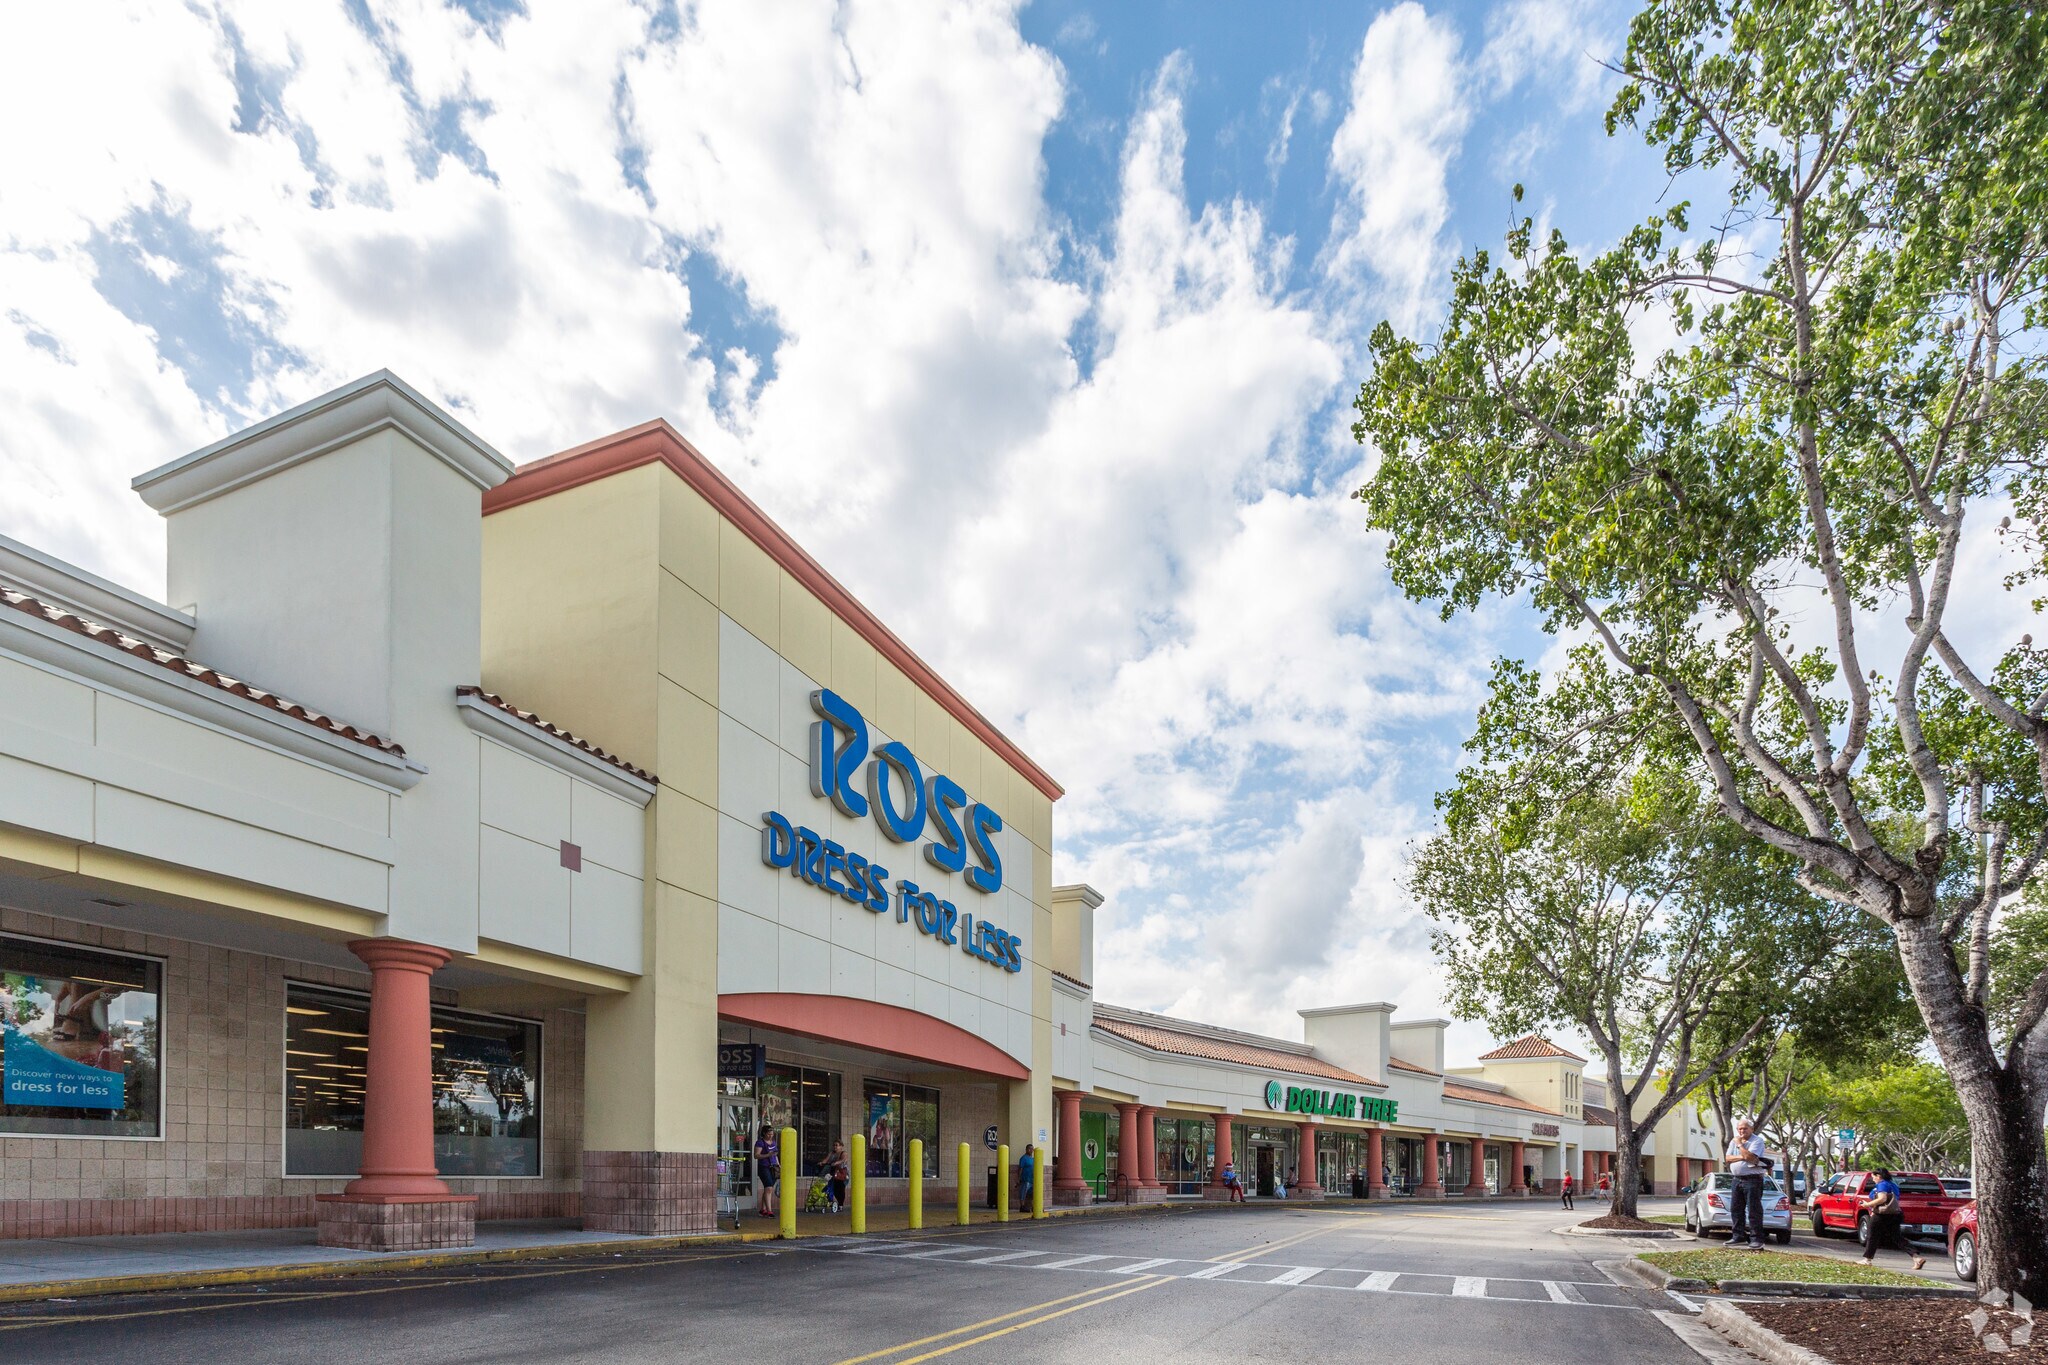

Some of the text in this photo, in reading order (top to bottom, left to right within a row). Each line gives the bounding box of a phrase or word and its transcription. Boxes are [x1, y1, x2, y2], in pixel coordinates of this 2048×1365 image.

[810, 688, 1002, 893] ROSS
[762, 811, 1021, 973] DRESS FOR LESS
[720, 1049, 752, 1064] OSS
[11, 1068, 51, 1079] Discover
[77, 1074, 100, 1083] ways
[11, 1080, 109, 1096] dress for less
[1286, 1086, 1399, 1122] DOLLAR TREE
[1087, 1143, 1095, 1159] $1
